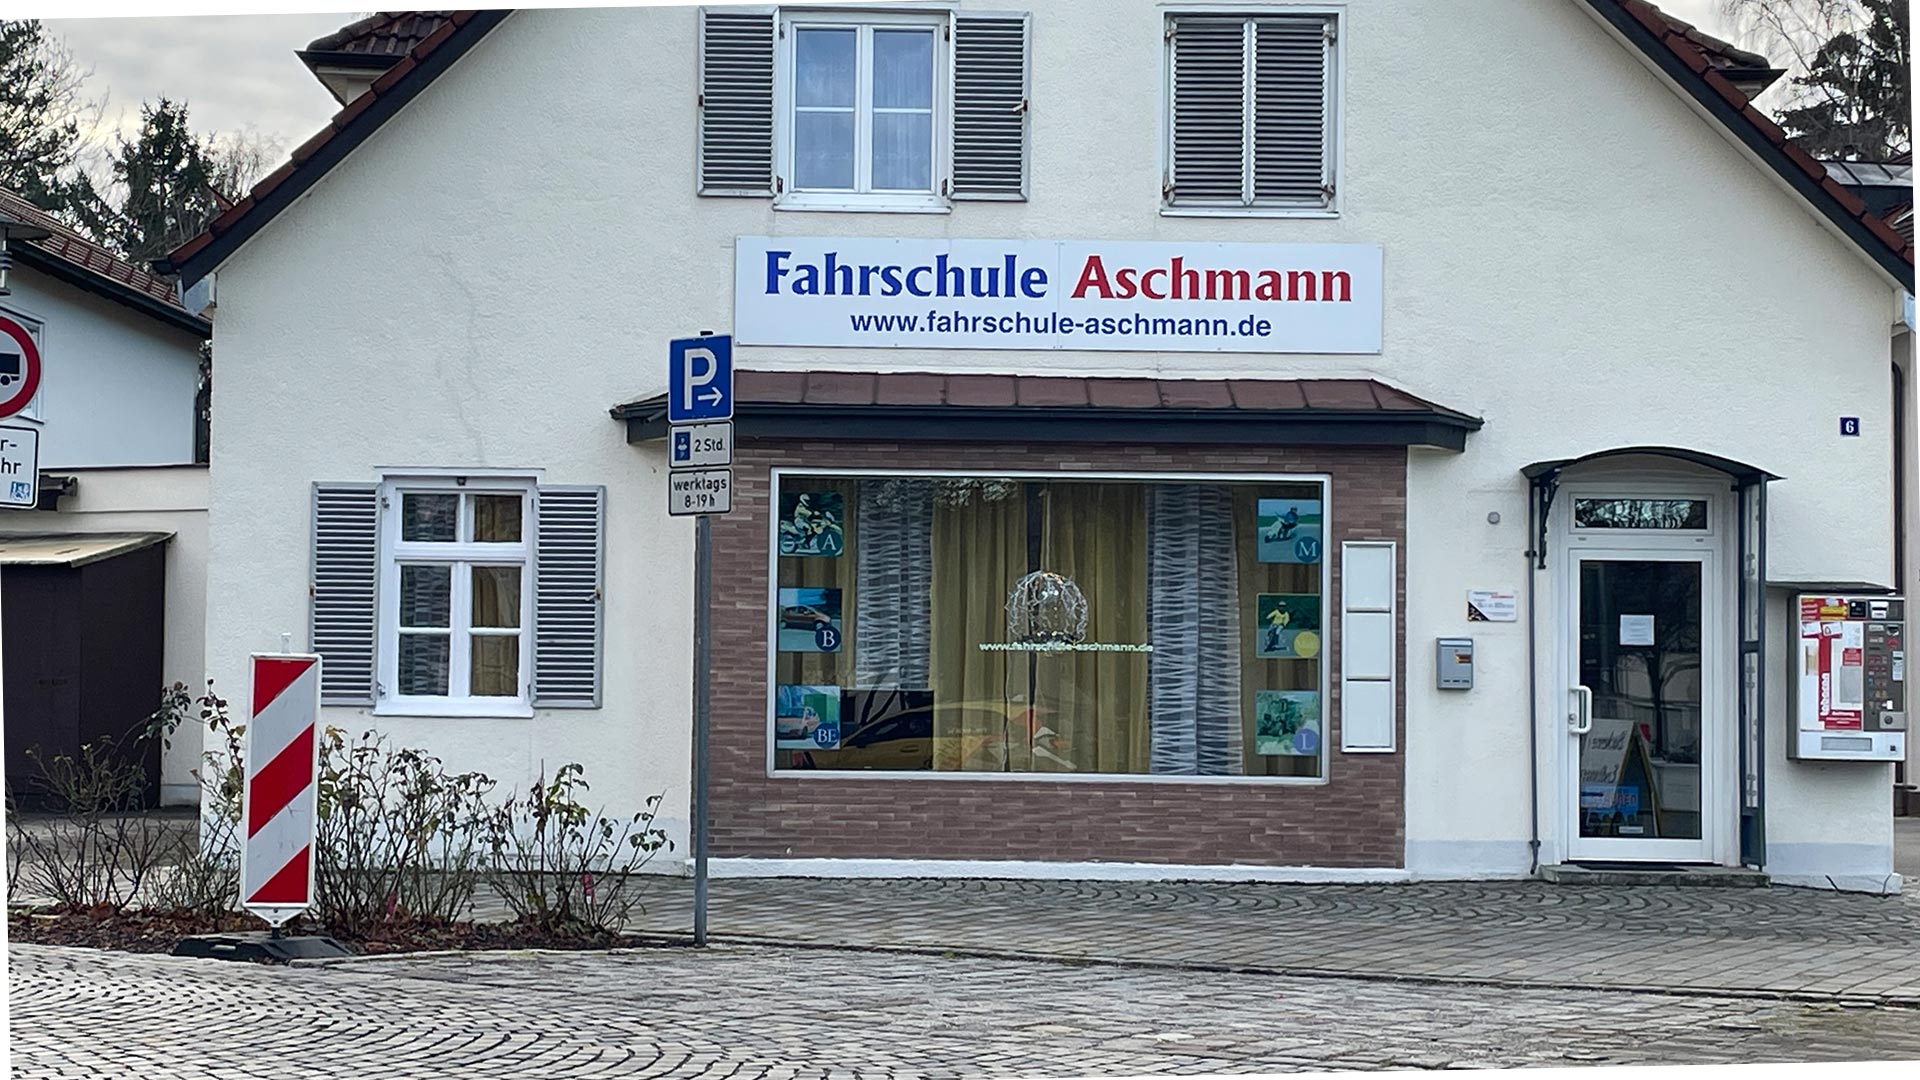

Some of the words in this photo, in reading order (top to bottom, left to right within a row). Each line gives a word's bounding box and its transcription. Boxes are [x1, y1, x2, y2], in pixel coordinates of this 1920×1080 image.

[765, 251, 1048, 298] Fahrschule
[1071, 255, 1353, 302] Aschmann
[850, 310, 1272, 337] www.fahrschule-aschmann.de
[684, 347, 717, 410] P
[1845, 420, 1855, 433] 6
[694, 439, 701, 452] 2
[673, 477, 727, 493] werktags
[684, 494, 707, 508] 8-19
[822, 534, 837, 551] A
[1299, 541, 1317, 557] M
[822, 630, 834, 647] B
[817, 730, 838, 743] BE
[1301, 733, 1313, 749] L
